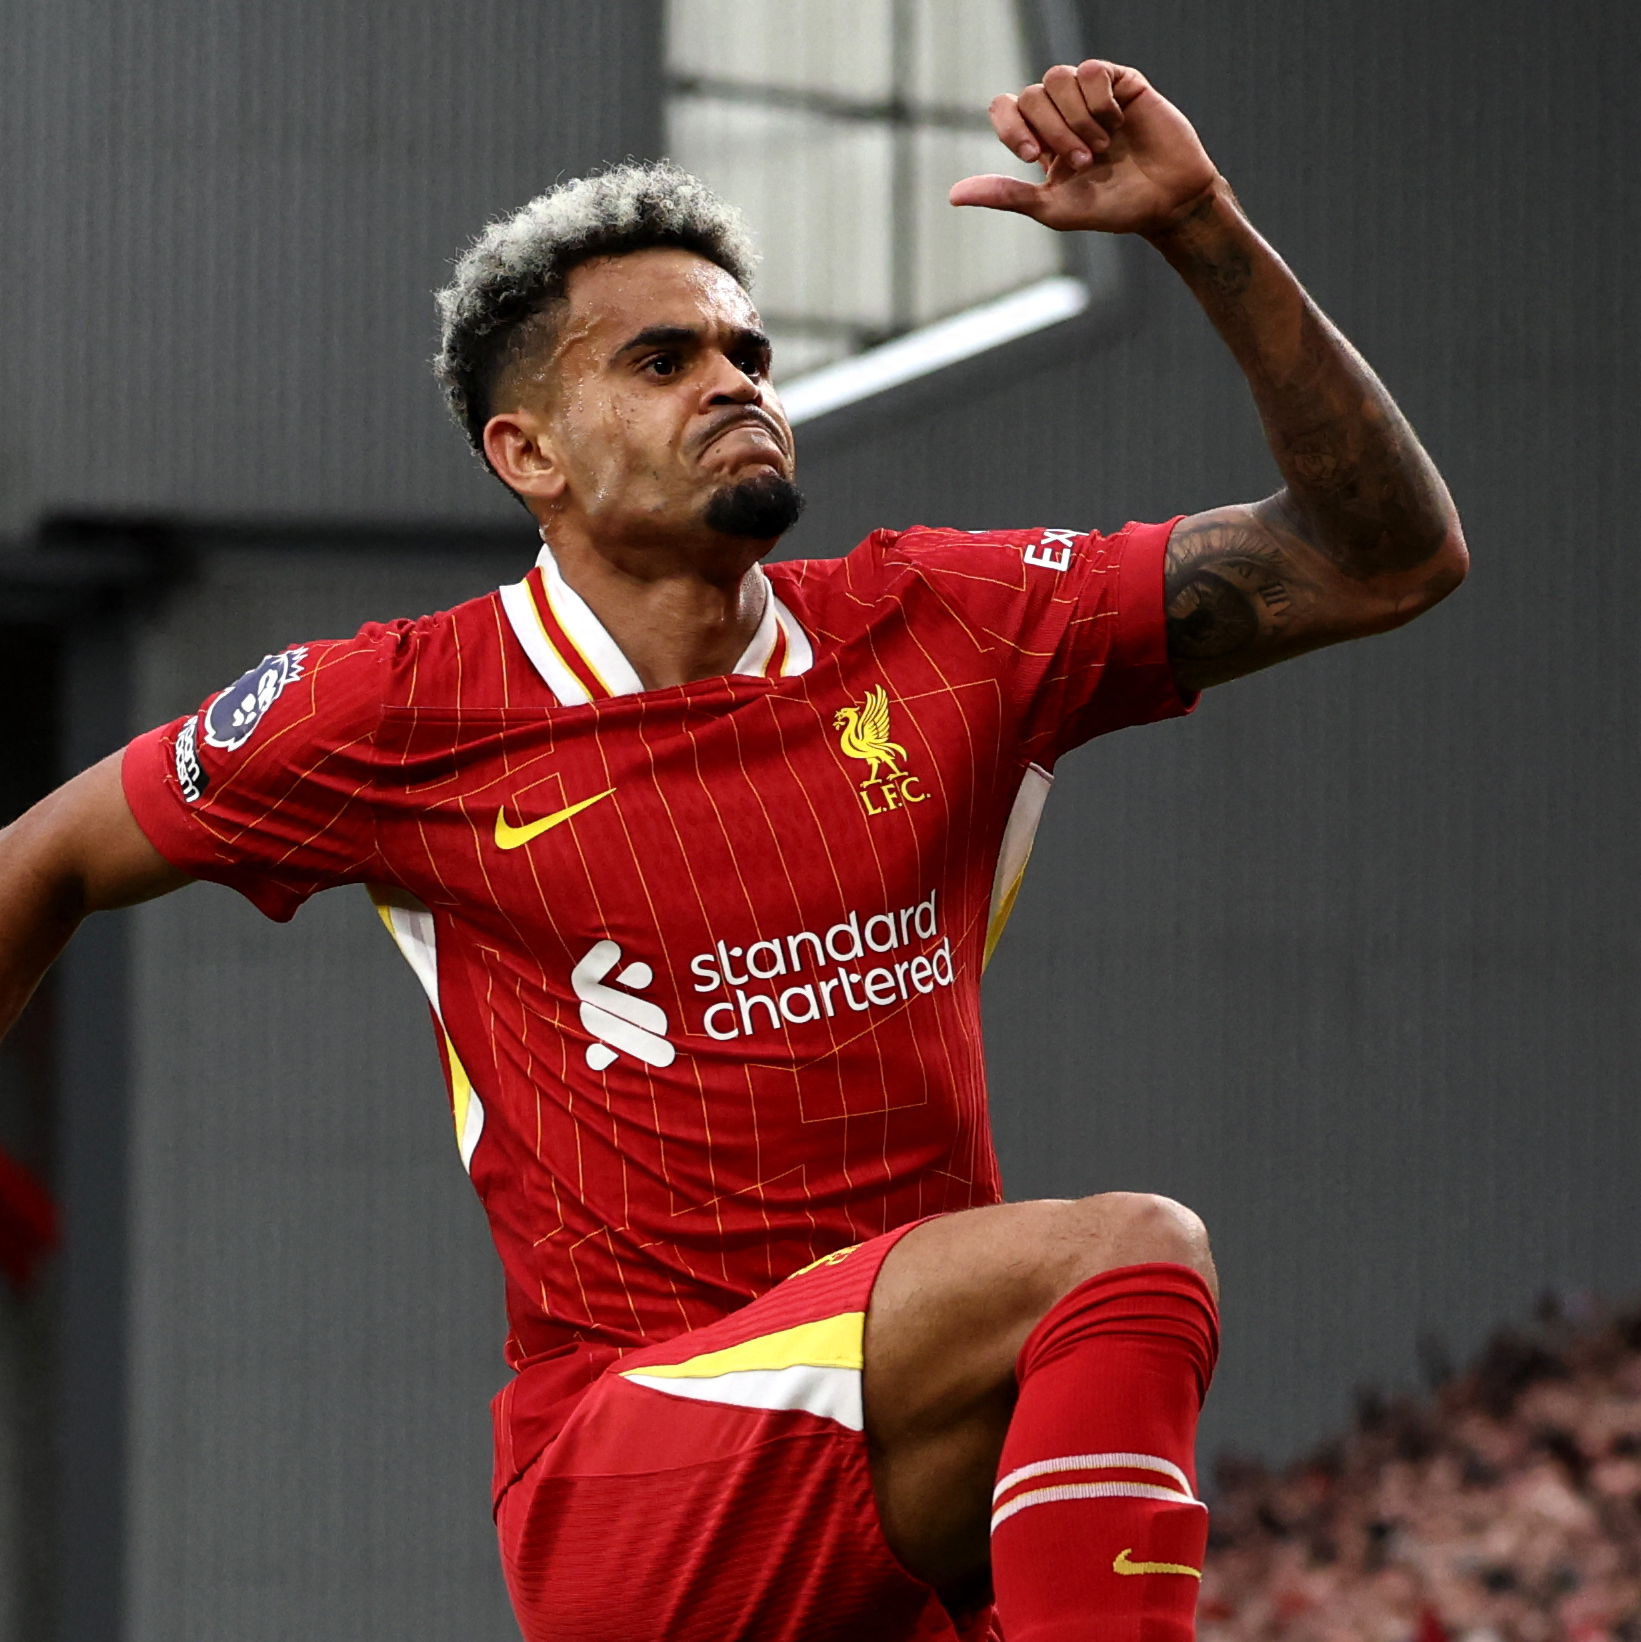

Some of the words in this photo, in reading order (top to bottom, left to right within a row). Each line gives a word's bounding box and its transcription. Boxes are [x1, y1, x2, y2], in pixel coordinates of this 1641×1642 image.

[1023, 528, 1089, 572] Ex
[690, 888, 938, 992] standard
[703, 936, 955, 1041] chartered
